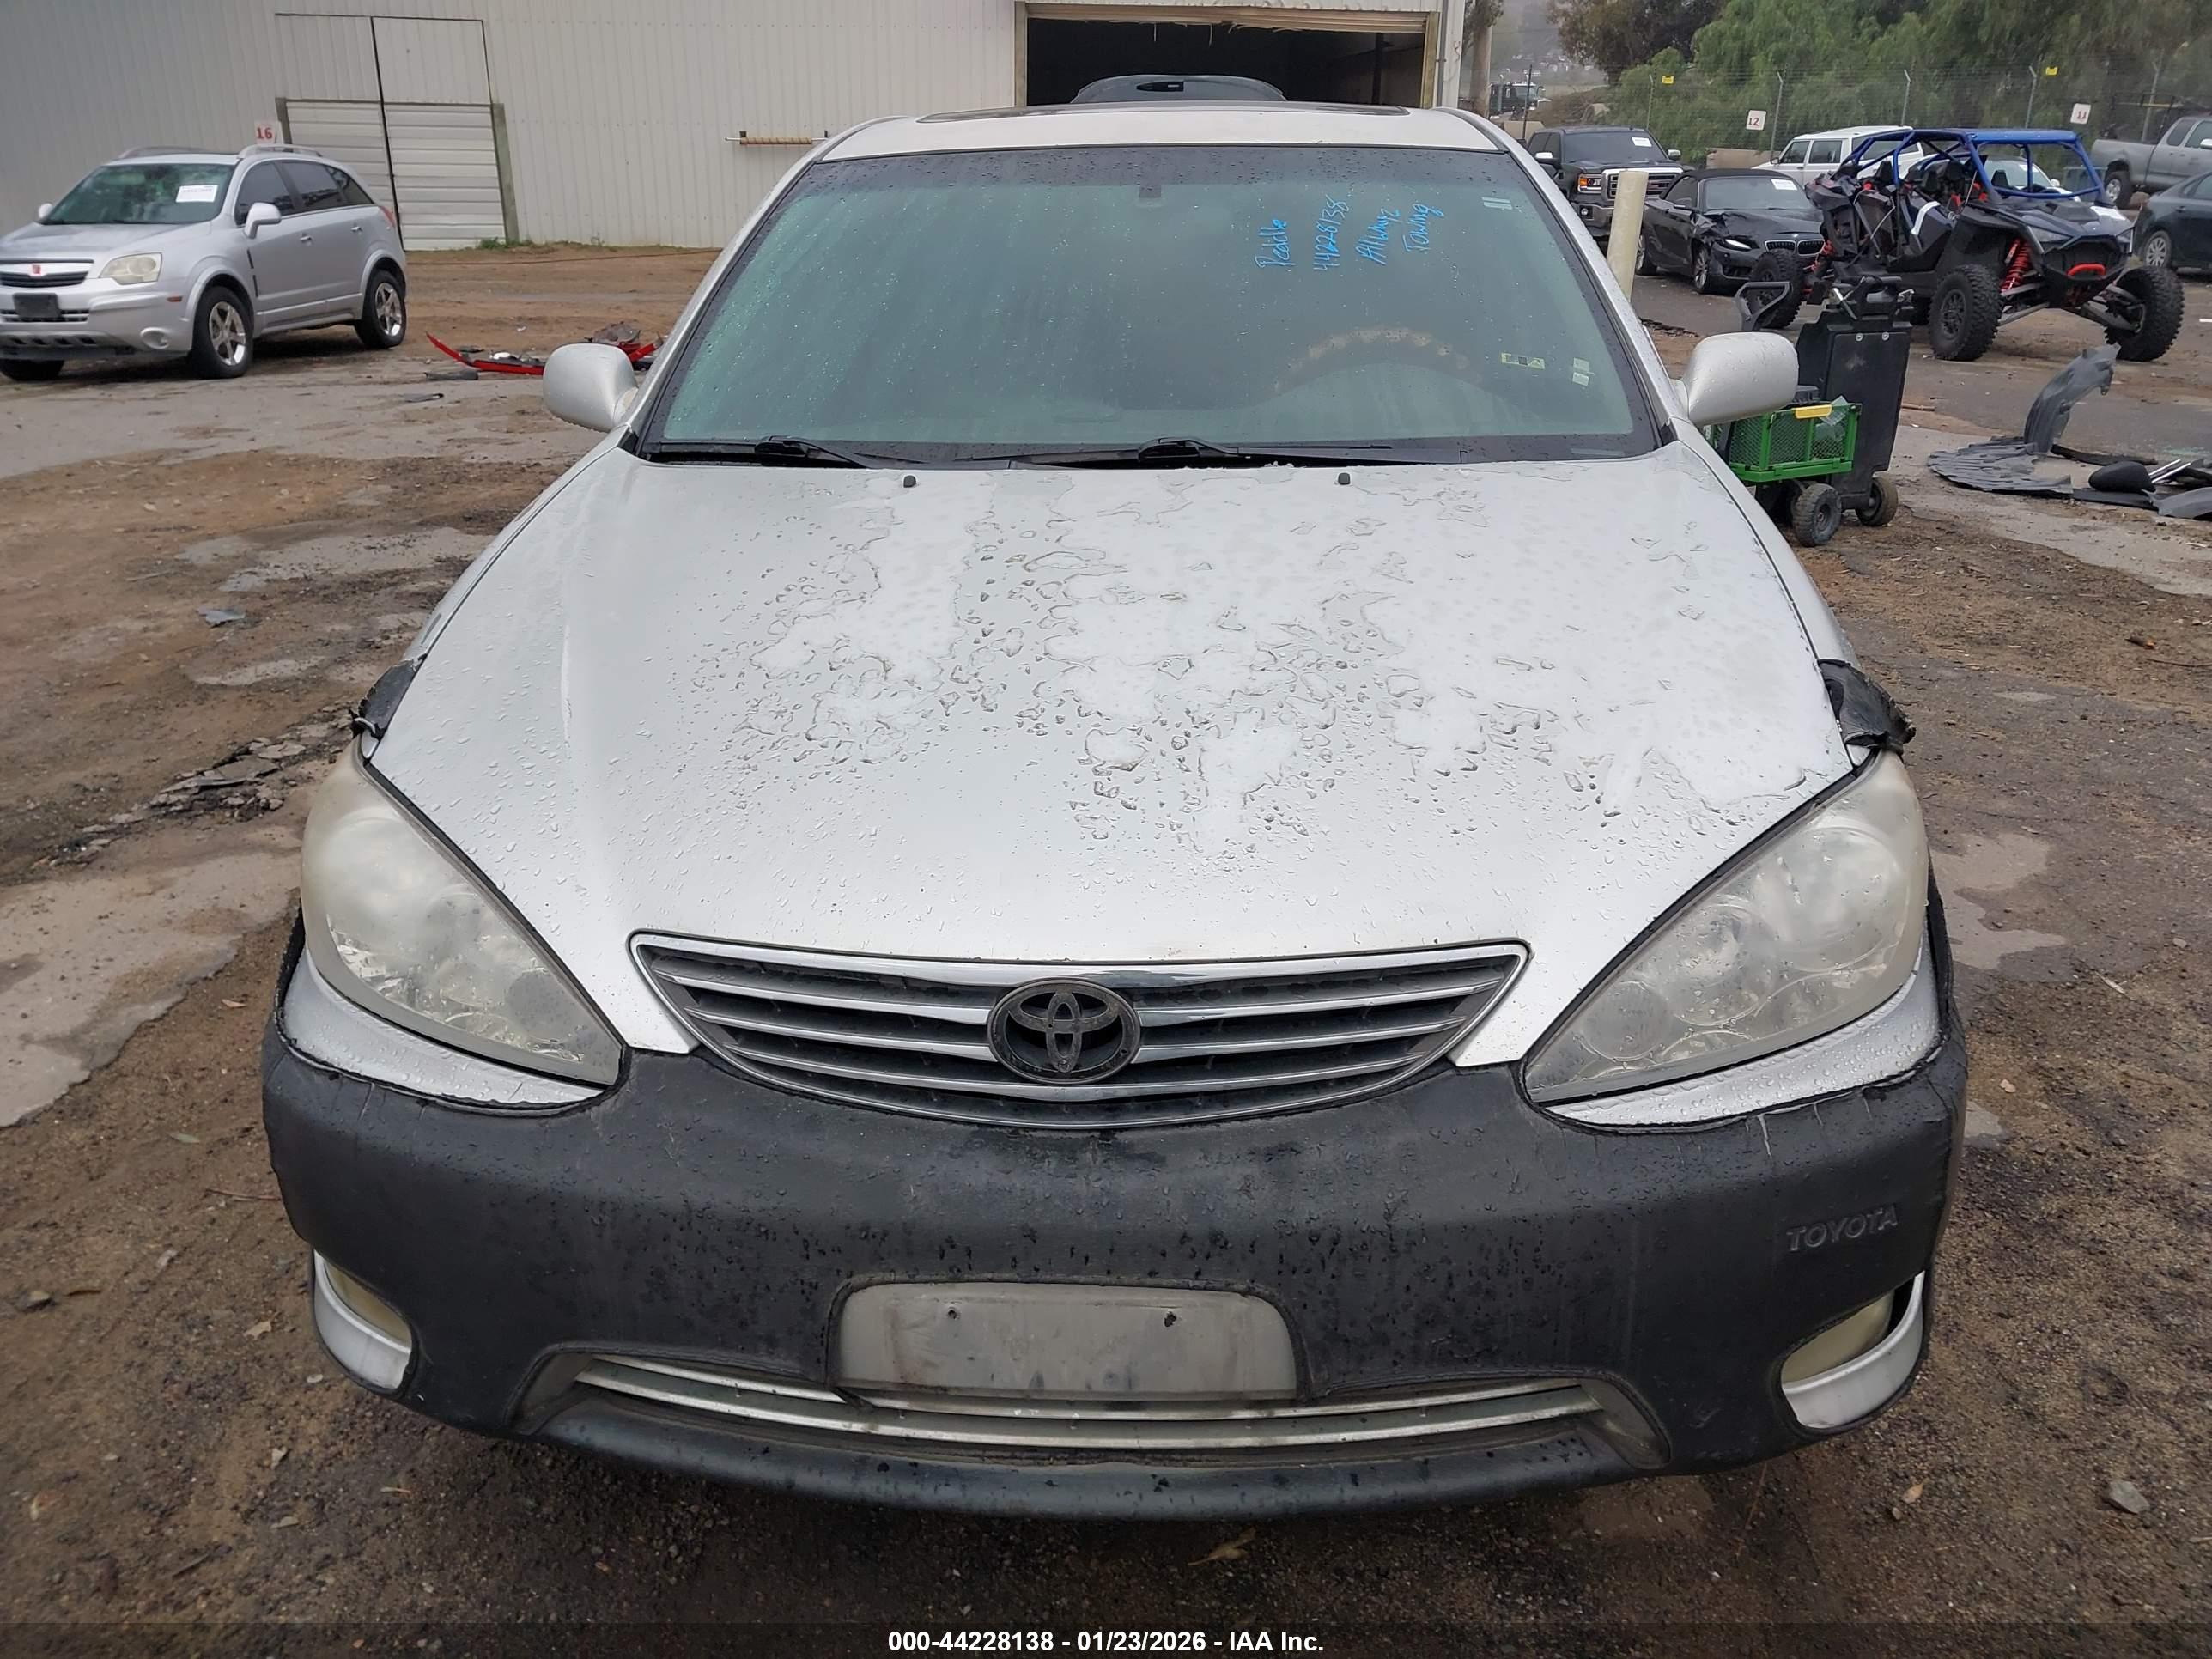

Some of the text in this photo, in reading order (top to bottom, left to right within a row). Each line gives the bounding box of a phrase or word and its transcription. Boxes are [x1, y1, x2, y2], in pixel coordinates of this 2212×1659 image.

[257, 127, 273, 139] 16
[1748, 117, 1759, 126] 12
[1313, 194, 1349, 270] 44228138
[1785, 1205, 1898, 1252] TOYOTA
